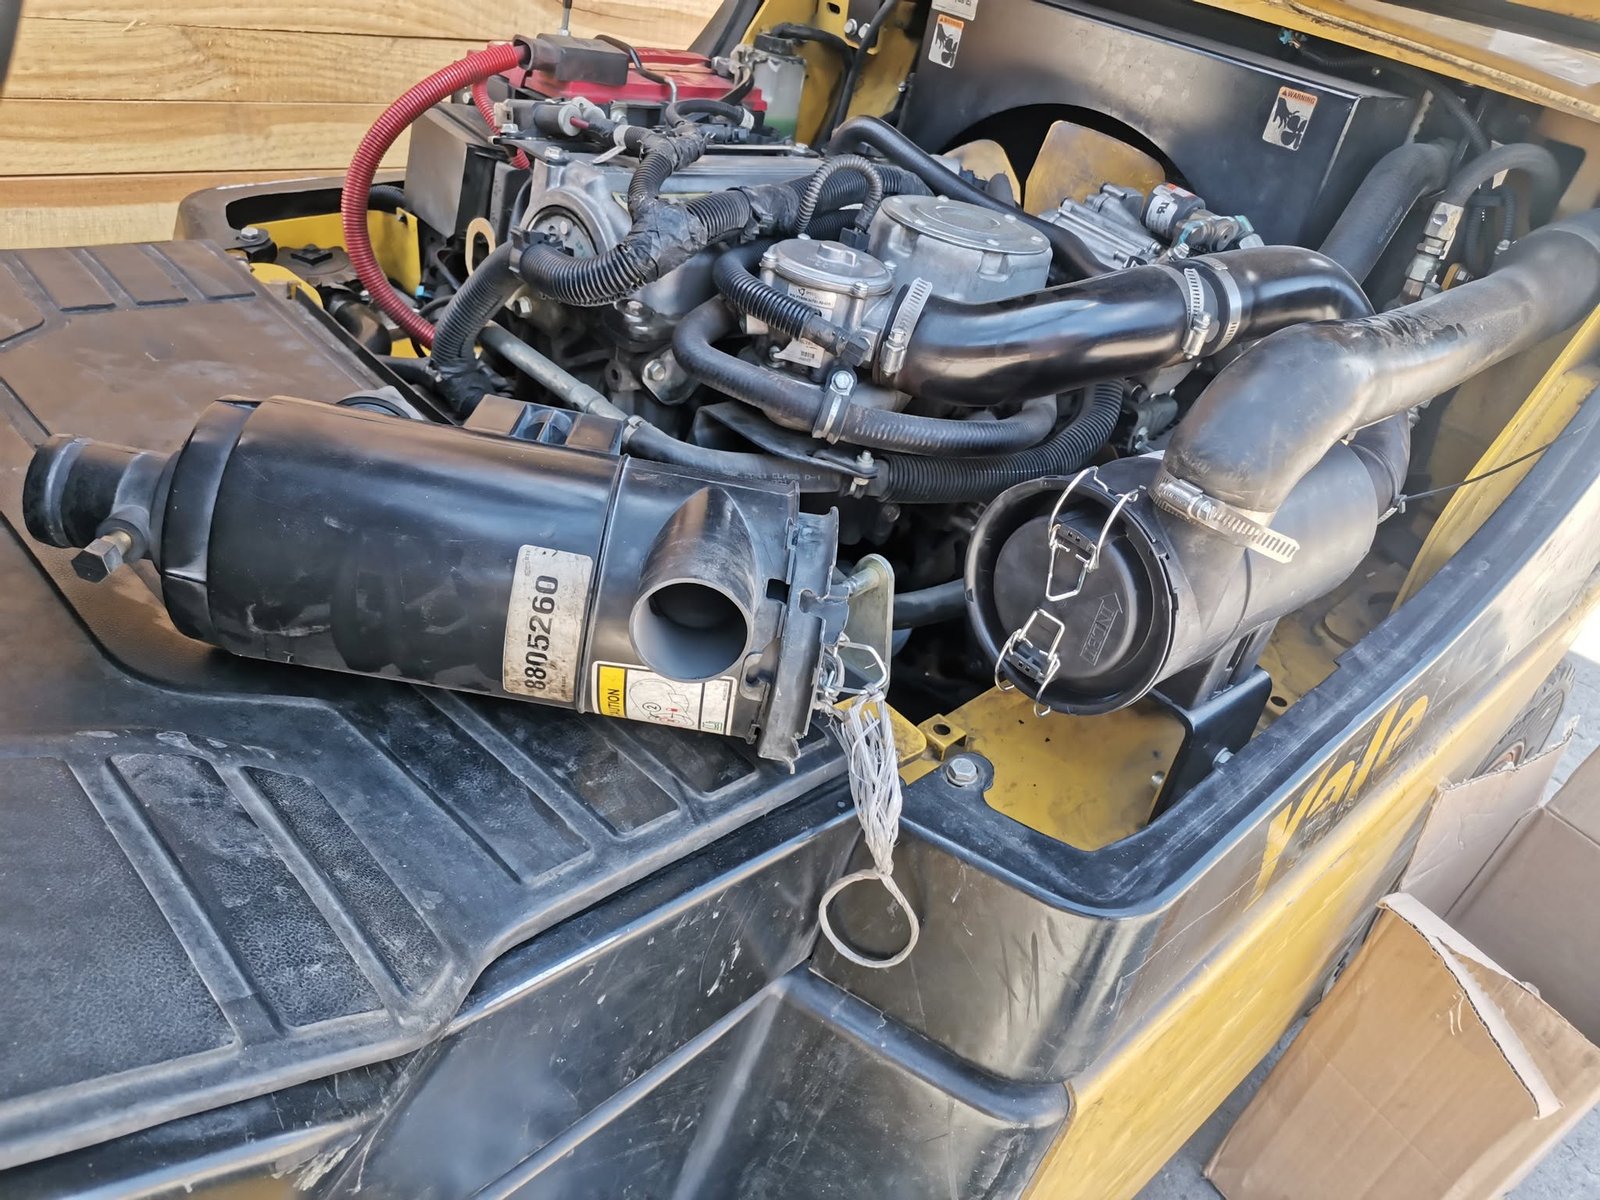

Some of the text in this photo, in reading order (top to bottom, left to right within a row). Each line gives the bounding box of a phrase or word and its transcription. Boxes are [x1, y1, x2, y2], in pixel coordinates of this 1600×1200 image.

[1287, 91, 1316, 104] WARNING
[524, 575, 559, 691] 8805260
[1243, 695, 1429, 913] Yale
